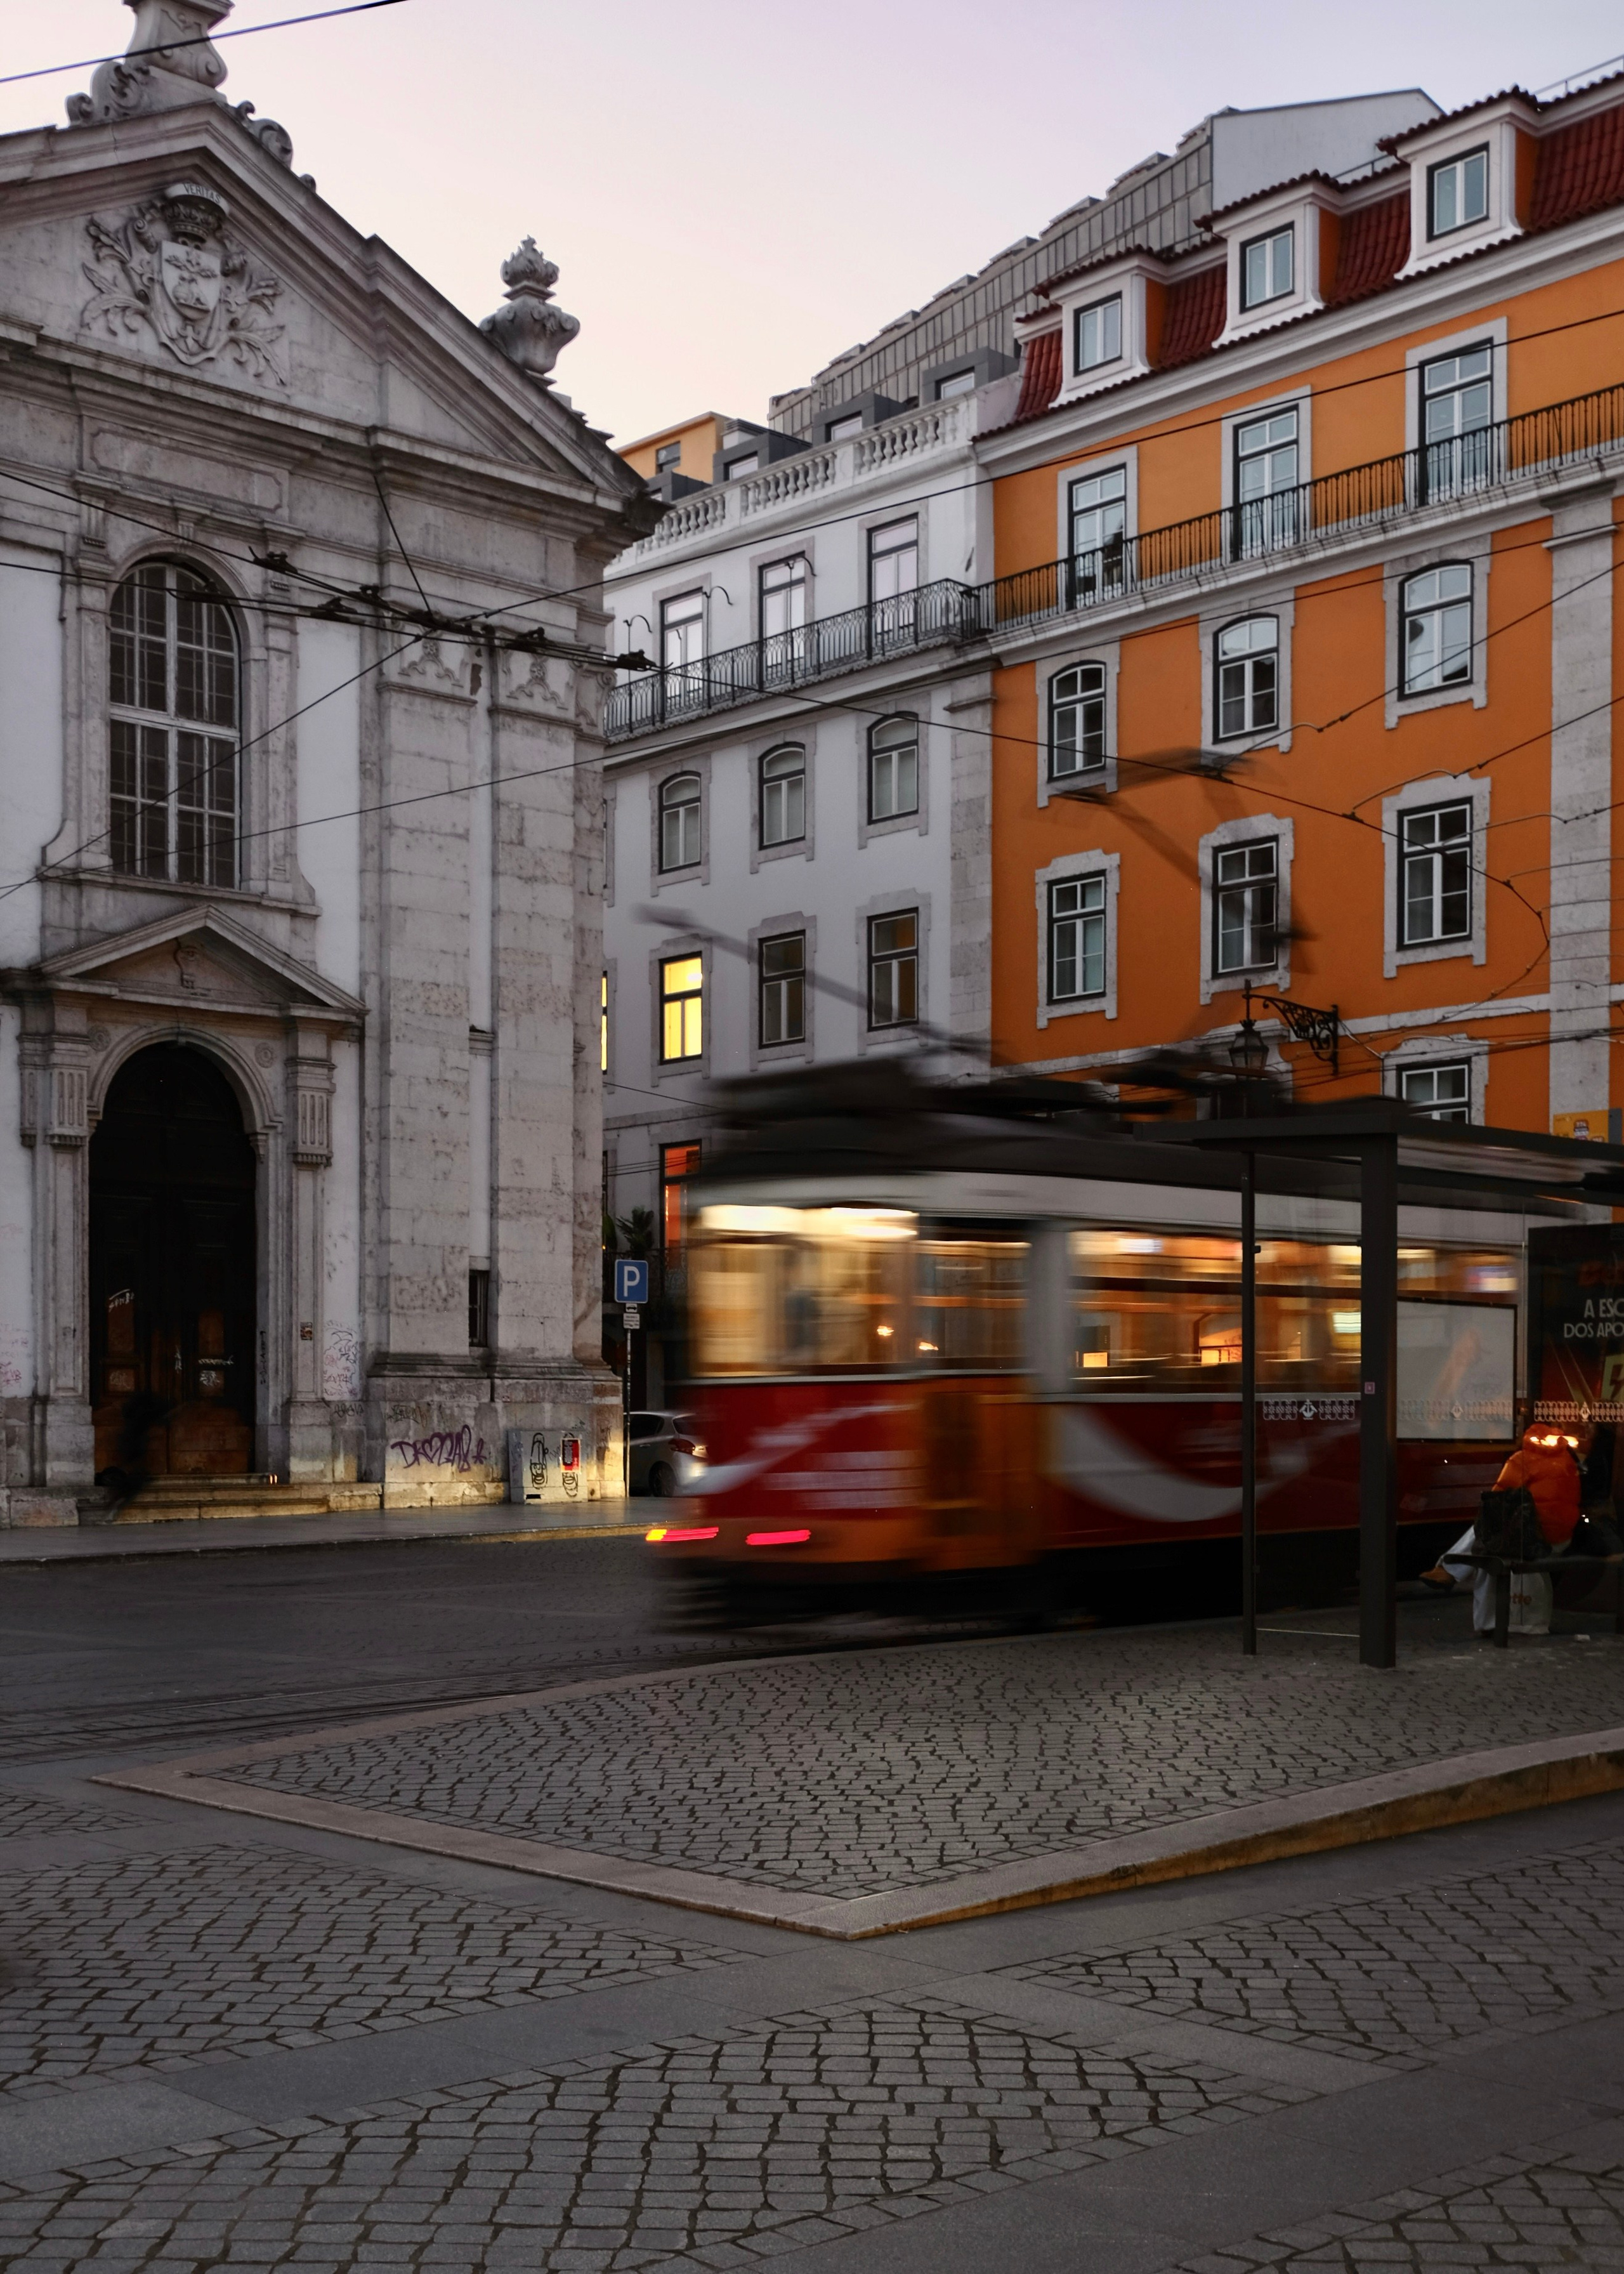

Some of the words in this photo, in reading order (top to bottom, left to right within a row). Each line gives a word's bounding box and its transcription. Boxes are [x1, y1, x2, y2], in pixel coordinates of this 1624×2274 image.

[183, 183, 221, 204] VERITAS
[624, 1266, 640, 1297] P
[1583, 1299, 1595, 1318] A
[1564, 1322, 1594, 1338] DOS
[1597, 1322, 1624, 1337] APO
